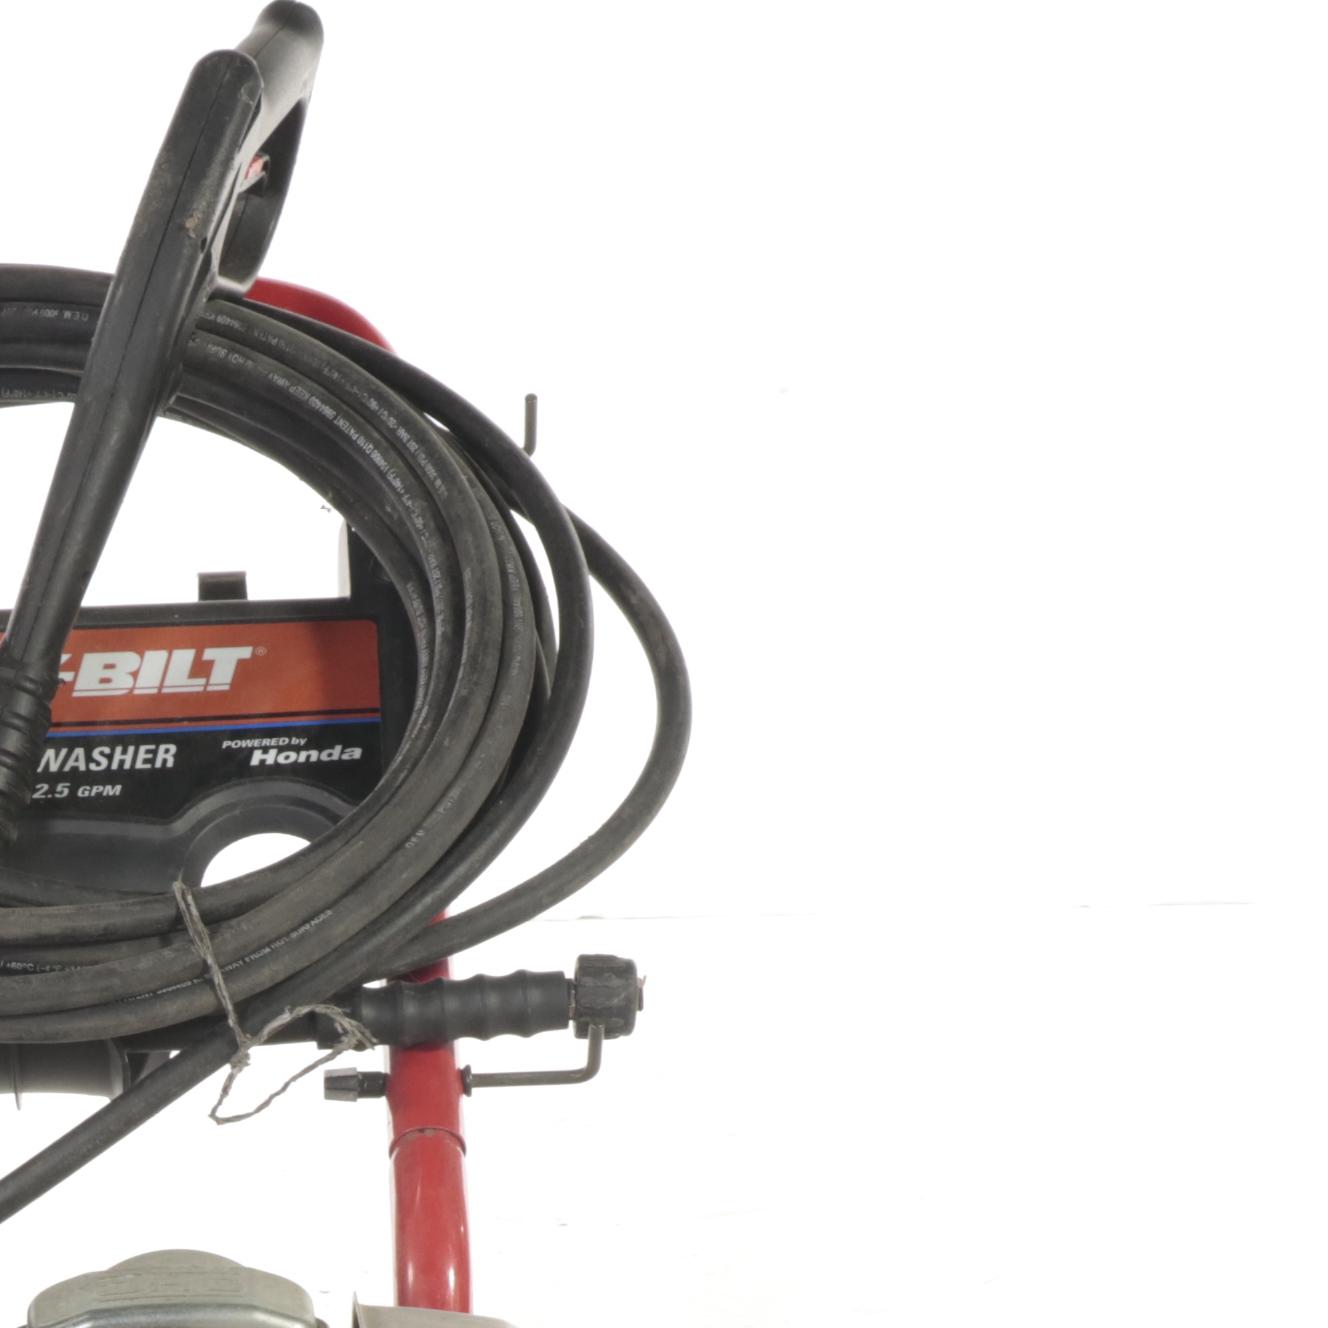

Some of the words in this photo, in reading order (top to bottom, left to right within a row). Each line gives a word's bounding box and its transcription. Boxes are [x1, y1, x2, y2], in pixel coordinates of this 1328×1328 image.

[222, 737, 289, 749] POWERED
[291, 737, 308, 746] by
[250, 744, 362, 766] Honda
[32, 783, 71, 798] 2.5
[77, 784, 122, 797] GPM
